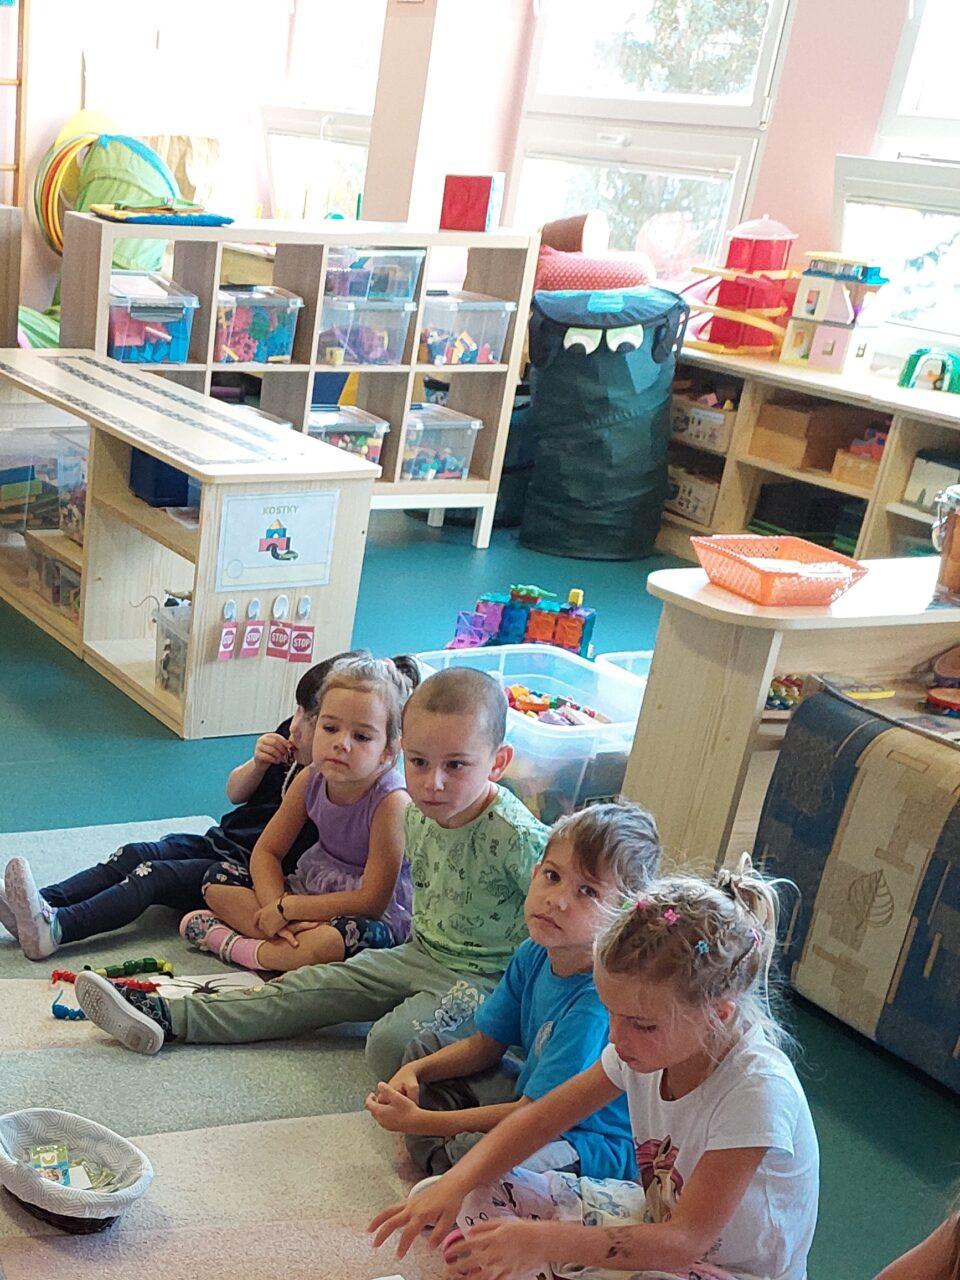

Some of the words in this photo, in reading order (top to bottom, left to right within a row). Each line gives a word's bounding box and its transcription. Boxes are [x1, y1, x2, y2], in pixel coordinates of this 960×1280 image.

[262, 504, 299, 515] KOSTKY
[271, 633, 288, 644] STOP
[293, 638, 311, 648] STOP
